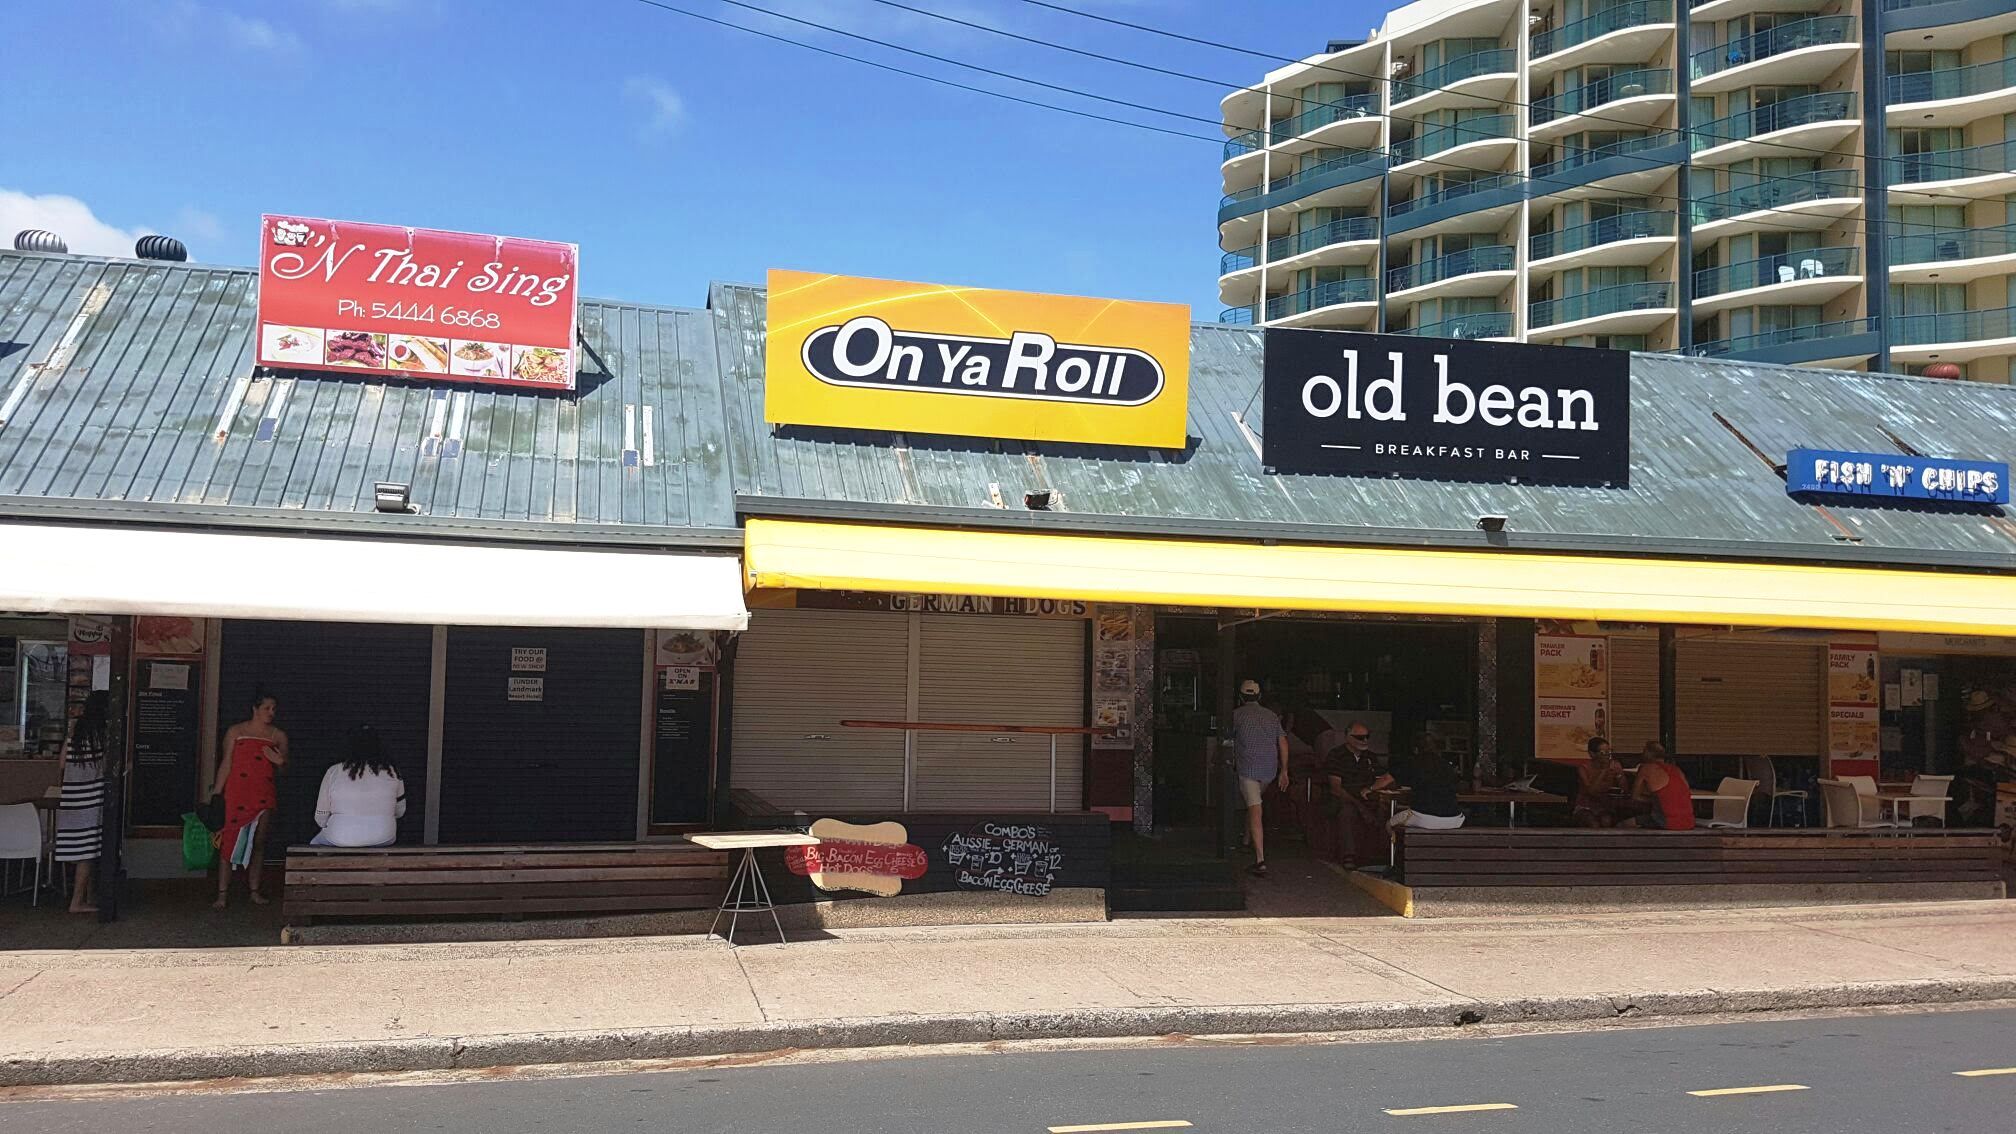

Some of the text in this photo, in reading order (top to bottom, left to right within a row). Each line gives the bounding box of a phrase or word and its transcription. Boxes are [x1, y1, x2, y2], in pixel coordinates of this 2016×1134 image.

[366, 247, 465, 290] Thai
[466, 261, 570, 307] Sing
[338, 299, 501, 329] Ph: 5444 6868
[832, 316, 1127, 396] On Ya Roll
[1301, 350, 1599, 431] old bean
[1375, 443, 1530, 461] BREAKFAST BAR
[1814, 458, 1873, 486] FISH
[1921, 467, 1999, 493] CHIPS
[891, 594, 992, 613] GERMAN
[1830, 653, 1856, 661] FAMILY
[1540, 710, 1571, 718] BASKET
[1830, 711, 1864, 719] SPECIALS
[951, 834, 992, 850] AUSSIE
[1002, 838, 1049, 854] GERMAN
[805, 846, 825, 863] BIG
[825, 847, 864, 864] BACON
[959, 871, 993, 888] BACON
